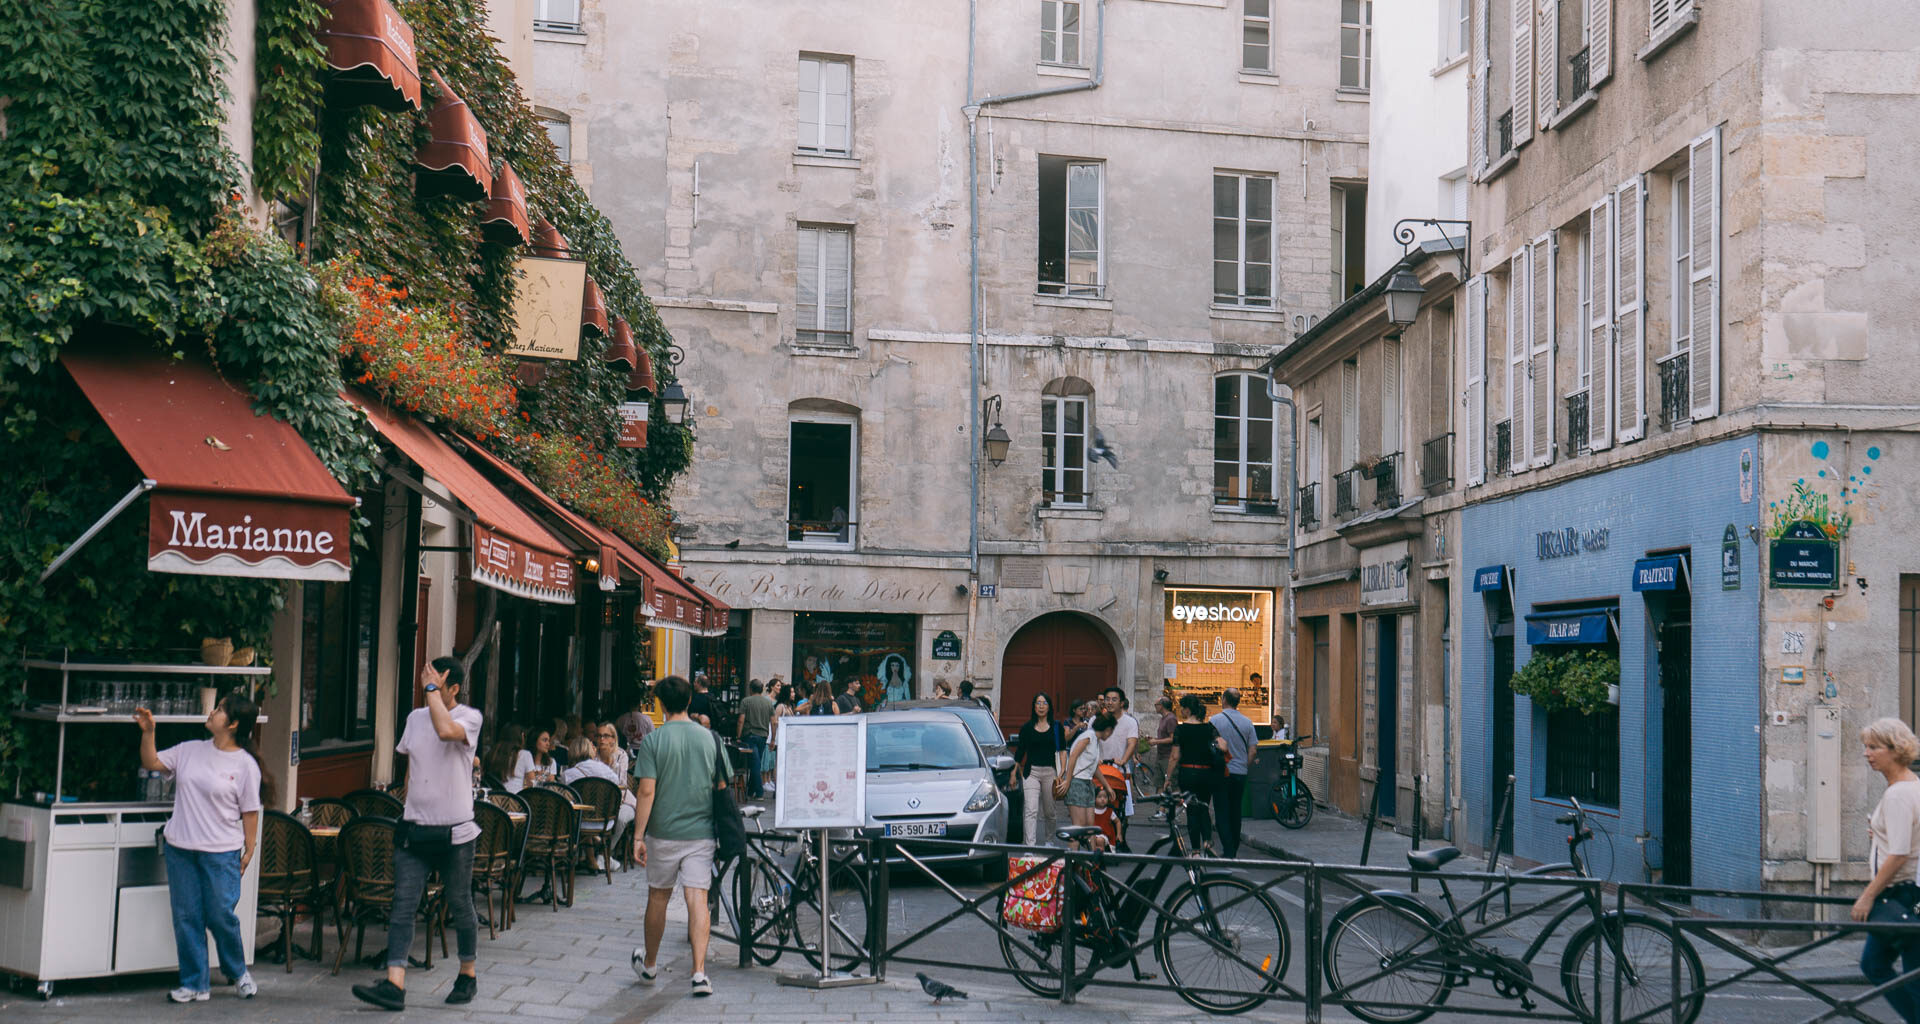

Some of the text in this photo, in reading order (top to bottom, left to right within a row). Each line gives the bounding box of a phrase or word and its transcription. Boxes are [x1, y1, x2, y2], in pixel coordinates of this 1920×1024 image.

[526, 338, 564, 354] Marianne
[168, 510, 334, 554] Marianne
[1536, 527, 1579, 560] IKAR
[1639, 567, 1674, 584] TRAITEUR
[820, 584, 845, 600] du
[853, 576, 943, 601] Désert
[981, 585, 994, 597] 27
[1172, 602, 1260, 624] eyeshow
[1549, 623, 1567, 638] IKAR
[1180, 636, 1235, 664] LE LAB
